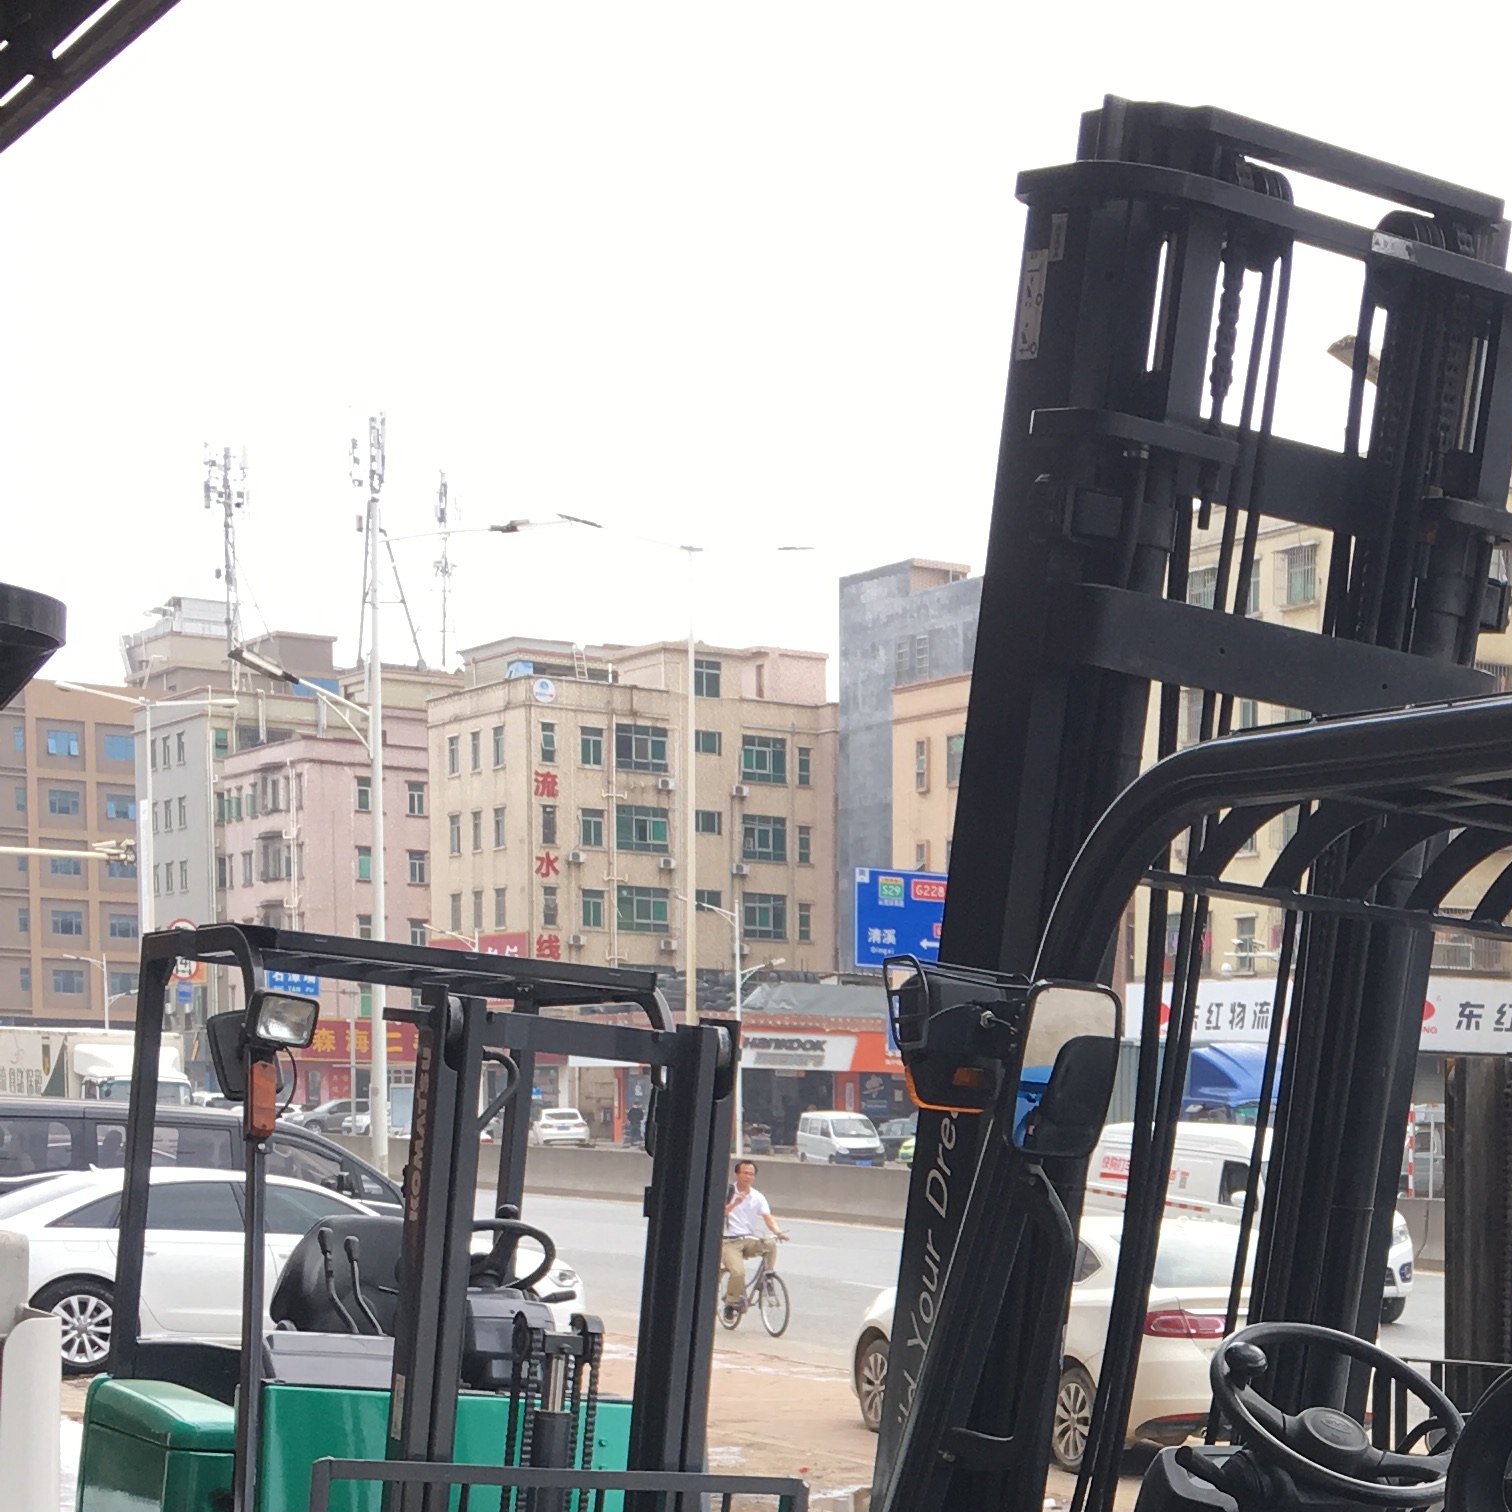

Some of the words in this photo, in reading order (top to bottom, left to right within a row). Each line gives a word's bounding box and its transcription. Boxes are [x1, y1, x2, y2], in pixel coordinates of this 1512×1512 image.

[312, 1027, 419, 1053] 森海二
[907, 1229, 942, 1351] Your
[925, 1112, 959, 1219] Dre
